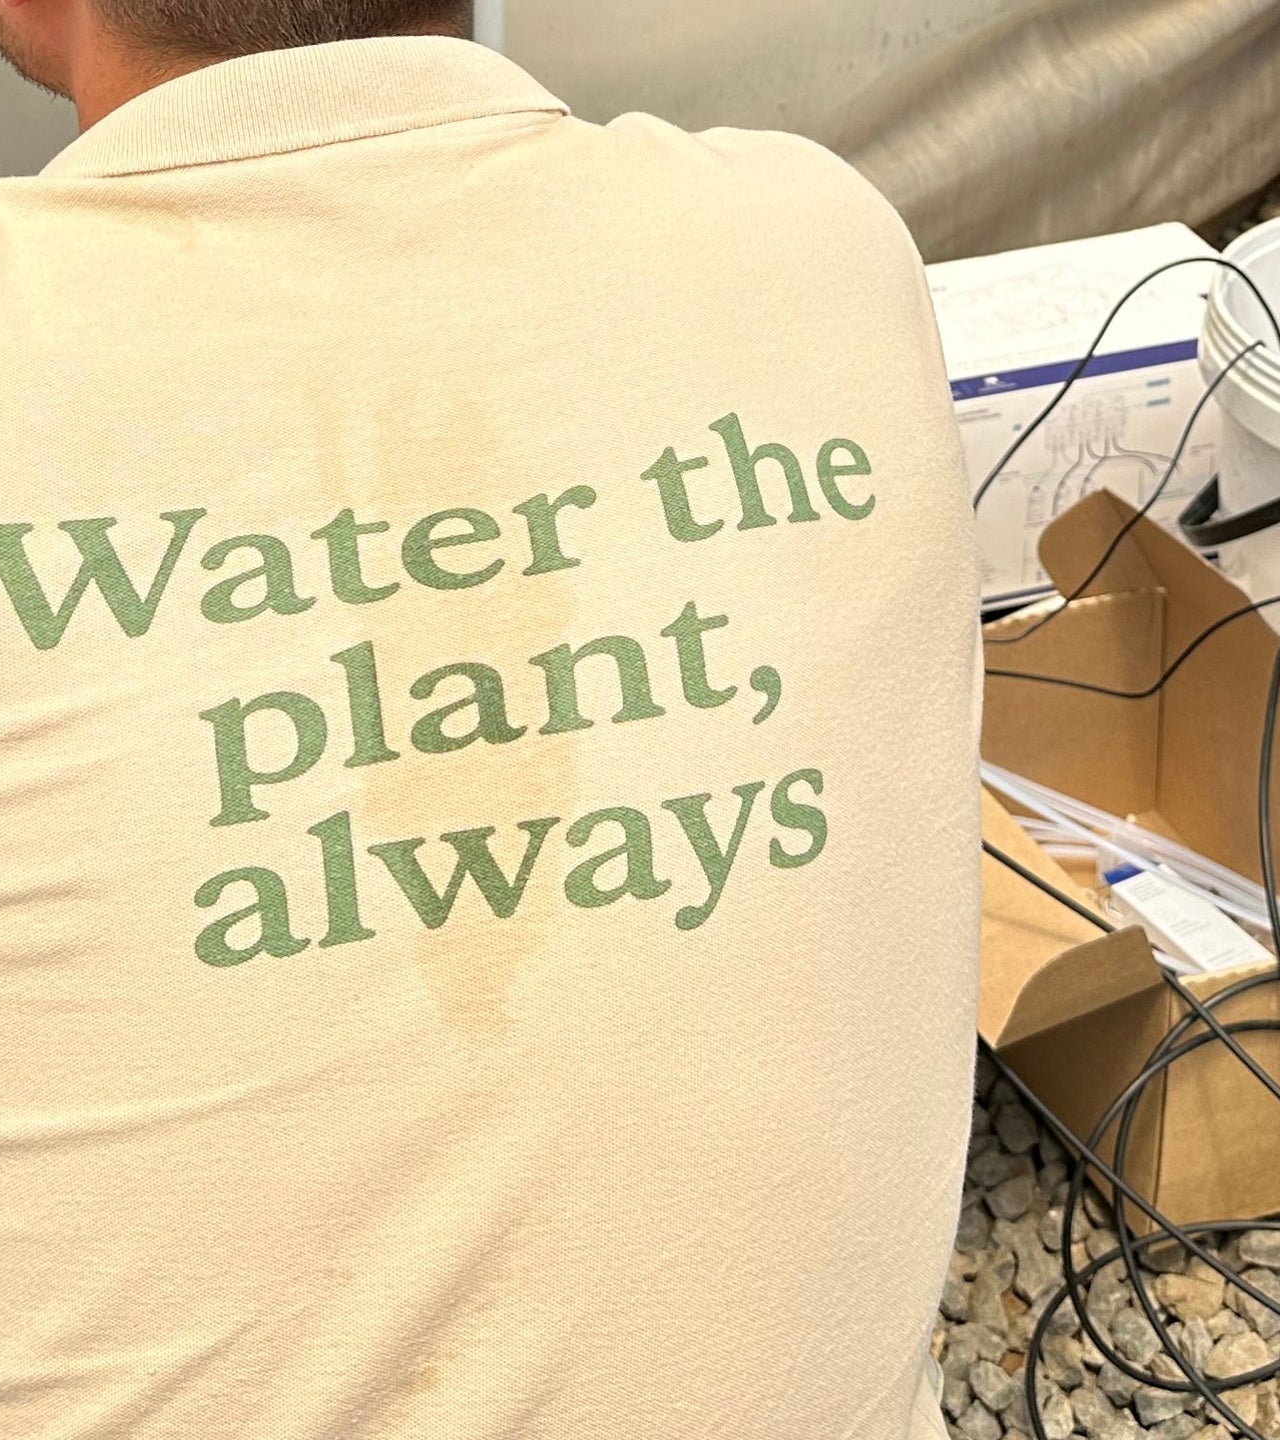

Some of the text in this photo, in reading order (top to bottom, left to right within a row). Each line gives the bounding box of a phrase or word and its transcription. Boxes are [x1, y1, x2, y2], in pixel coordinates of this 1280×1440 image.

[640, 412, 877, 543] the
[198, 600, 783, 828] plant,
[192, 766, 829, 968] always
